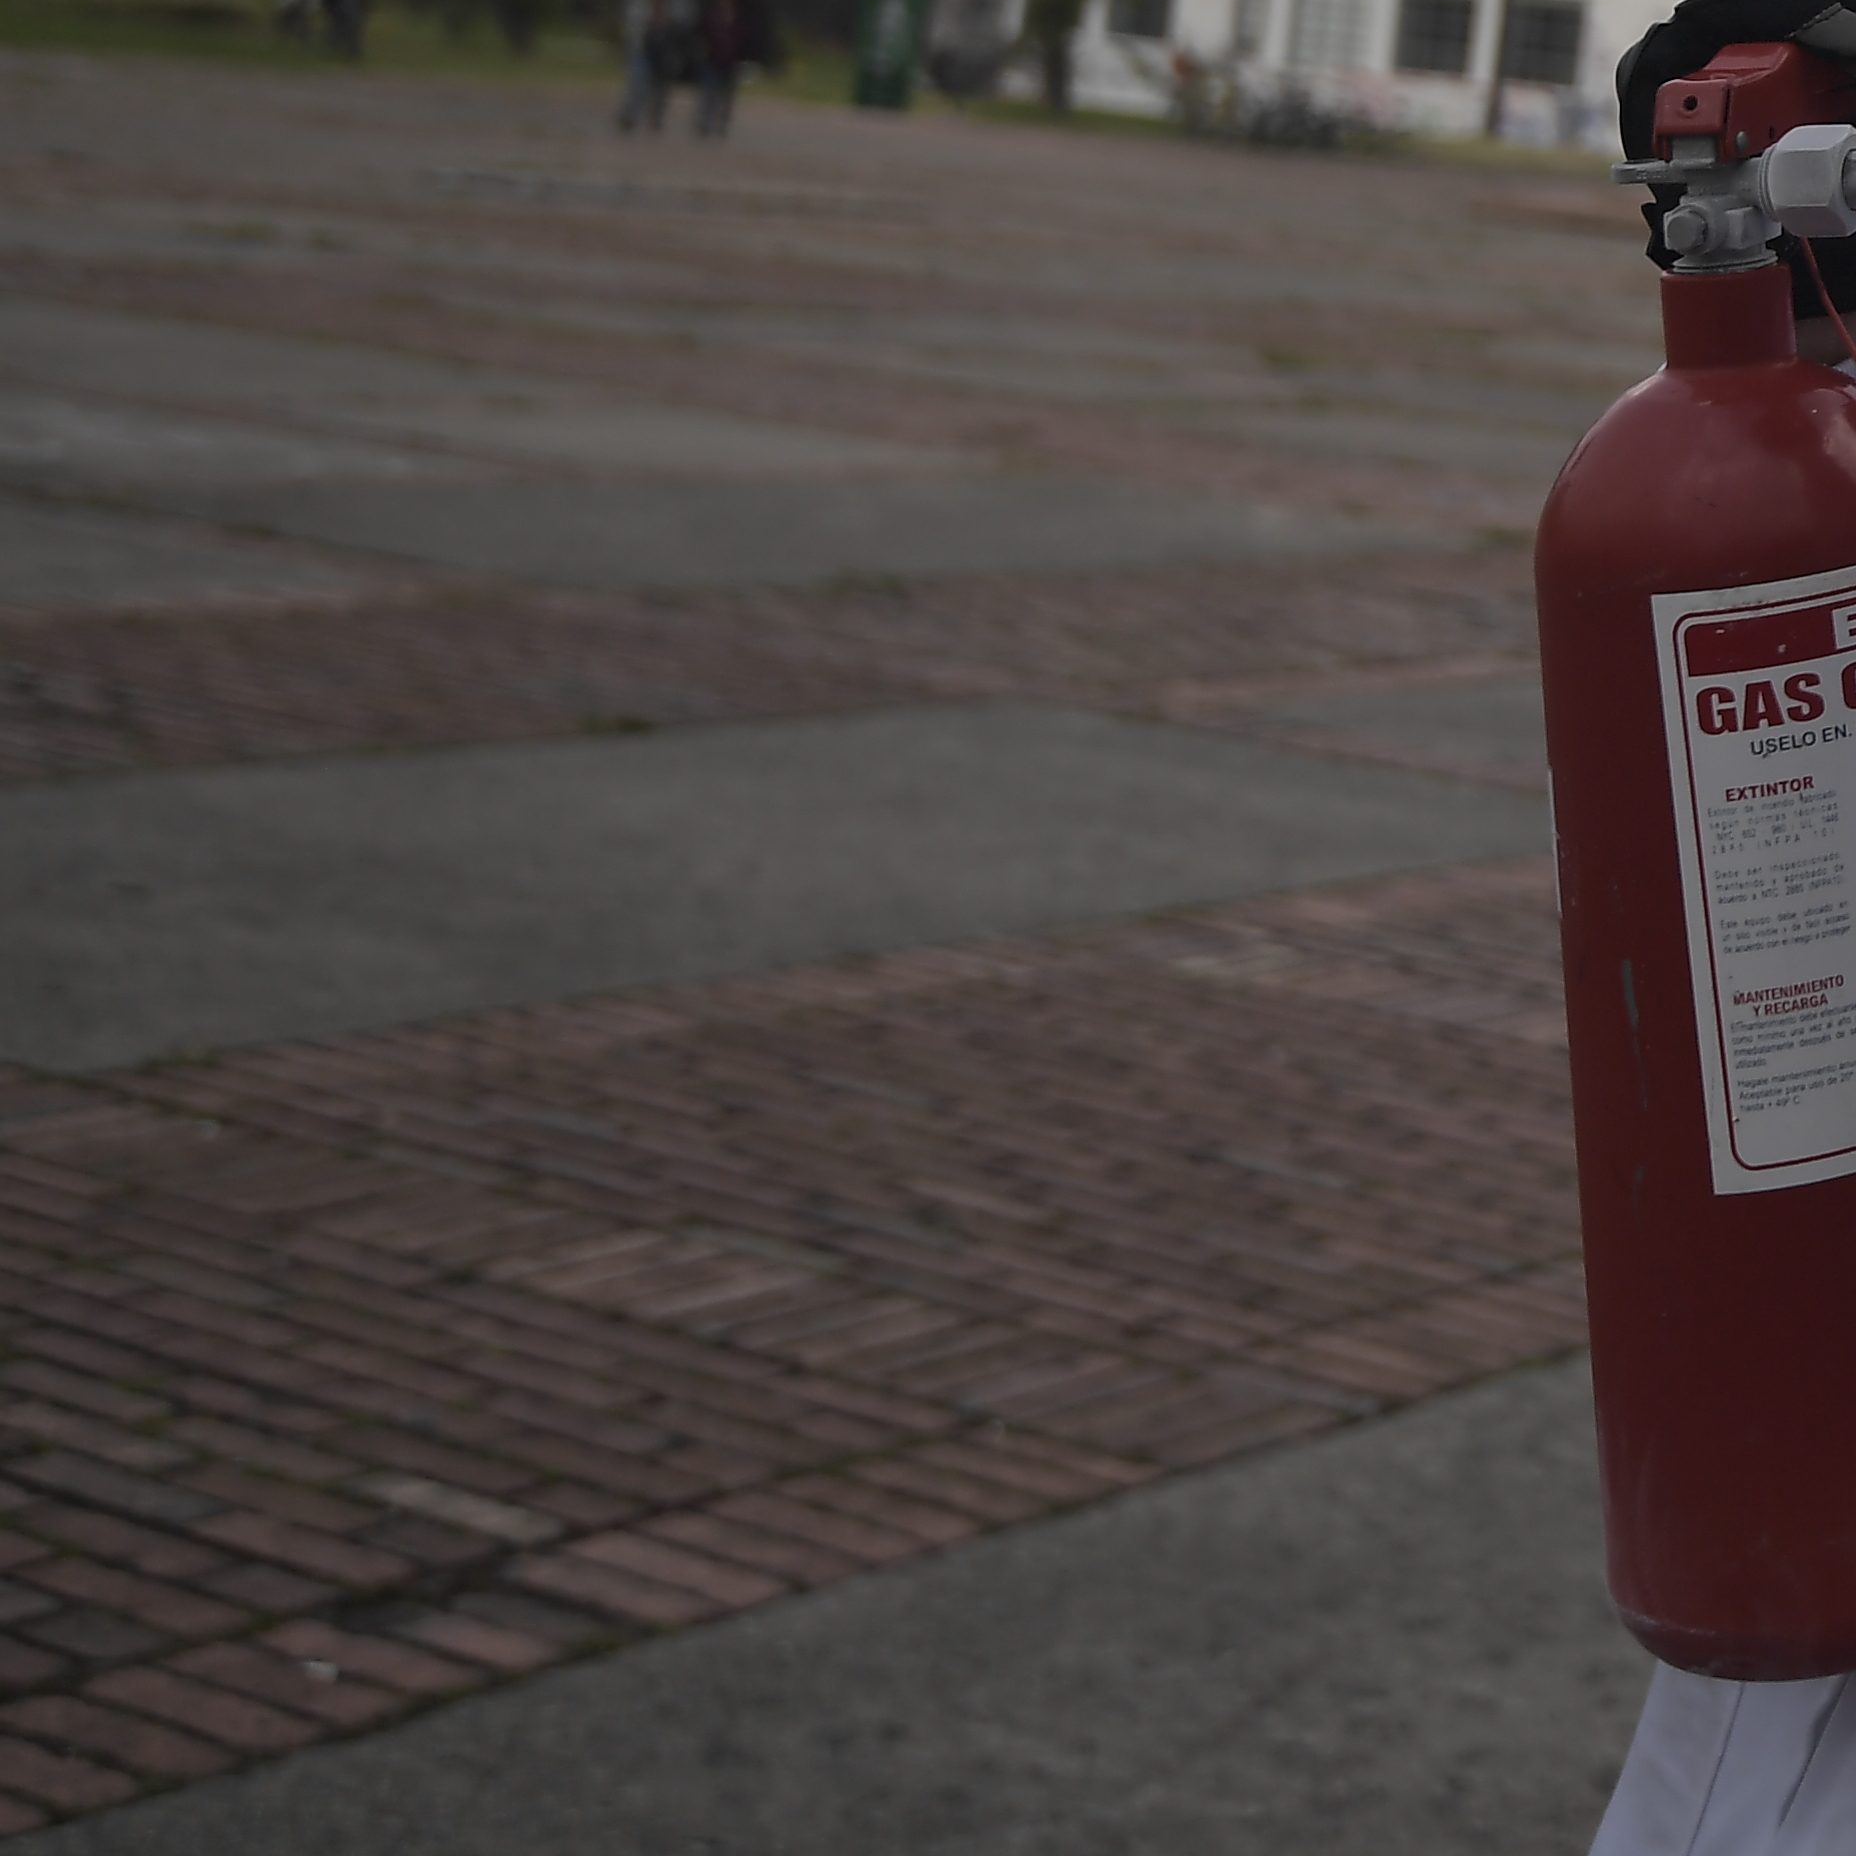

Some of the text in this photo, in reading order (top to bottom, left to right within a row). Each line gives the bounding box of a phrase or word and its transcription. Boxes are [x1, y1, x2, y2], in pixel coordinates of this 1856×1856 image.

[1696, 672, 1826, 735] GAS
[1750, 731, 1817, 757] USELO
[1726, 776, 1814, 802] EXTINTOR
[1733, 974, 1844, 1006] MANTENIMIENTO
[1753, 993, 1828, 1017] Y RECARGA
